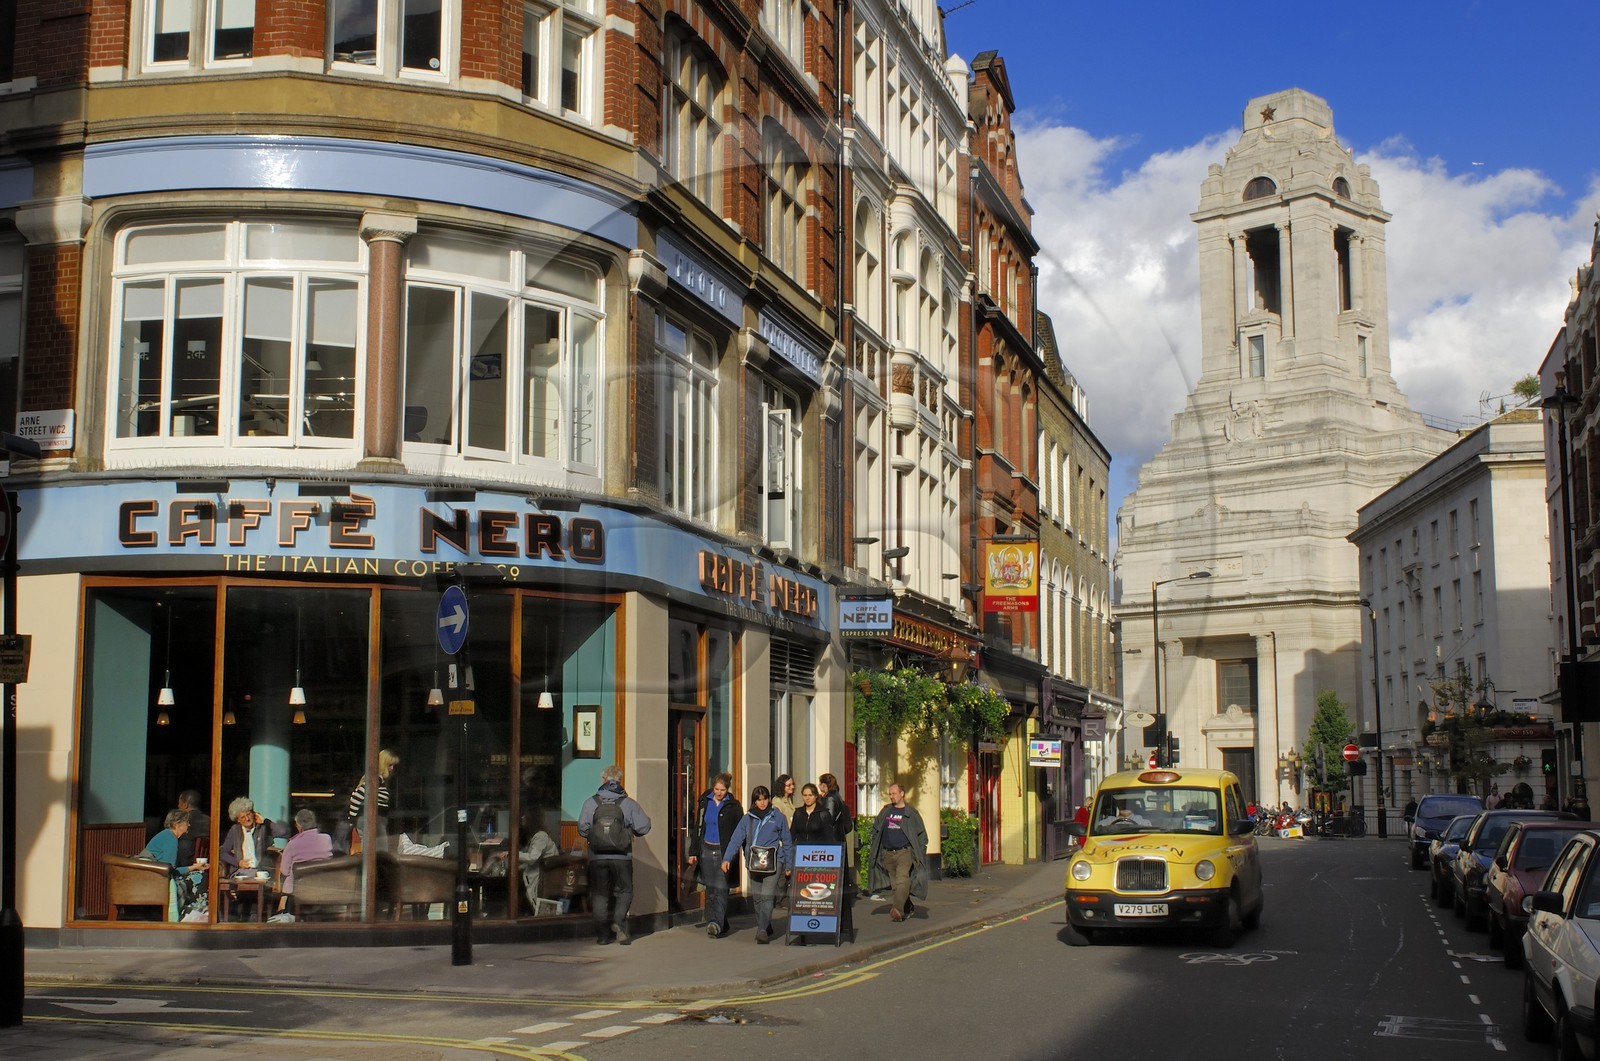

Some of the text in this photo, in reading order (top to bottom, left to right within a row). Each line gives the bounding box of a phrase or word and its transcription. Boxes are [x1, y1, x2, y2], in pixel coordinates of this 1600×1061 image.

[675, 253, 726, 310] PHOTO
[20, 416, 40, 426] ARNE
[20, 425, 66, 436] STREET WC2
[40, 440, 68, 448] ESTMINSTER
[119, 491, 605, 562] CAFFÈ NERO
[223, 554, 267, 572] THE
[281, 555, 380, 575] ITALIAN
[394, 559, 482, 577] COFF
[770, 573, 818, 620] NERO
[843, 612, 889, 623] NERO
[797, 874, 837, 883] HOT SOUP
[1118, 904, 1164, 914] V279 LGK
